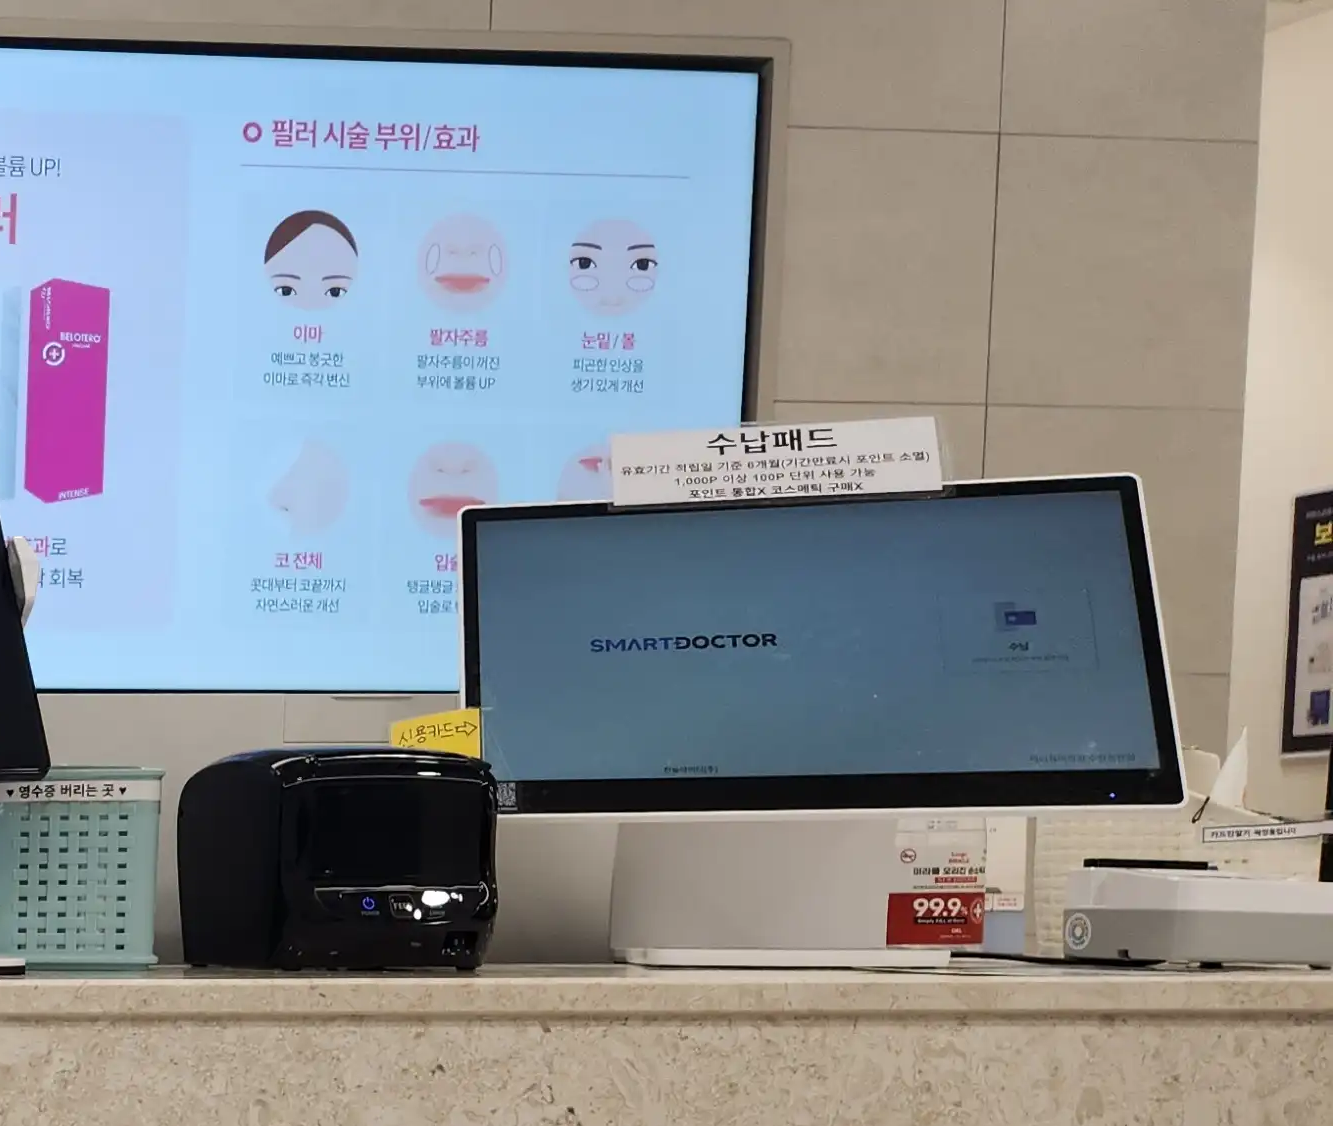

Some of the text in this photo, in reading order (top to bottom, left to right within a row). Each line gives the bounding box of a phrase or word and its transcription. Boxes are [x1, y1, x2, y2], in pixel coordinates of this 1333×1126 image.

[272, 120, 480, 152] 필러 시술 부위/효과
[30, 158, 61, 177] UP!
[294, 325, 323, 343] 이마
[430, 328, 488, 348] 팔자주름
[621, 332, 635, 350] 볼
[707, 429, 837, 455] 수납패드
[857, 453, 895, 463] 포인트
[675, 468, 875, 486] 1,000P 이상 100P 단위 사용 가능
[58, 489, 89, 499] INTENSE
[689, 489, 726, 498] 포인트
[275, 552, 322, 569] 코 전체
[50, 568, 84, 588] 회복
[591, 634, 777, 652] SMARTDOCTOR
[61, 784, 98, 797] 버리는
[102, 784, 114, 797] 곳
